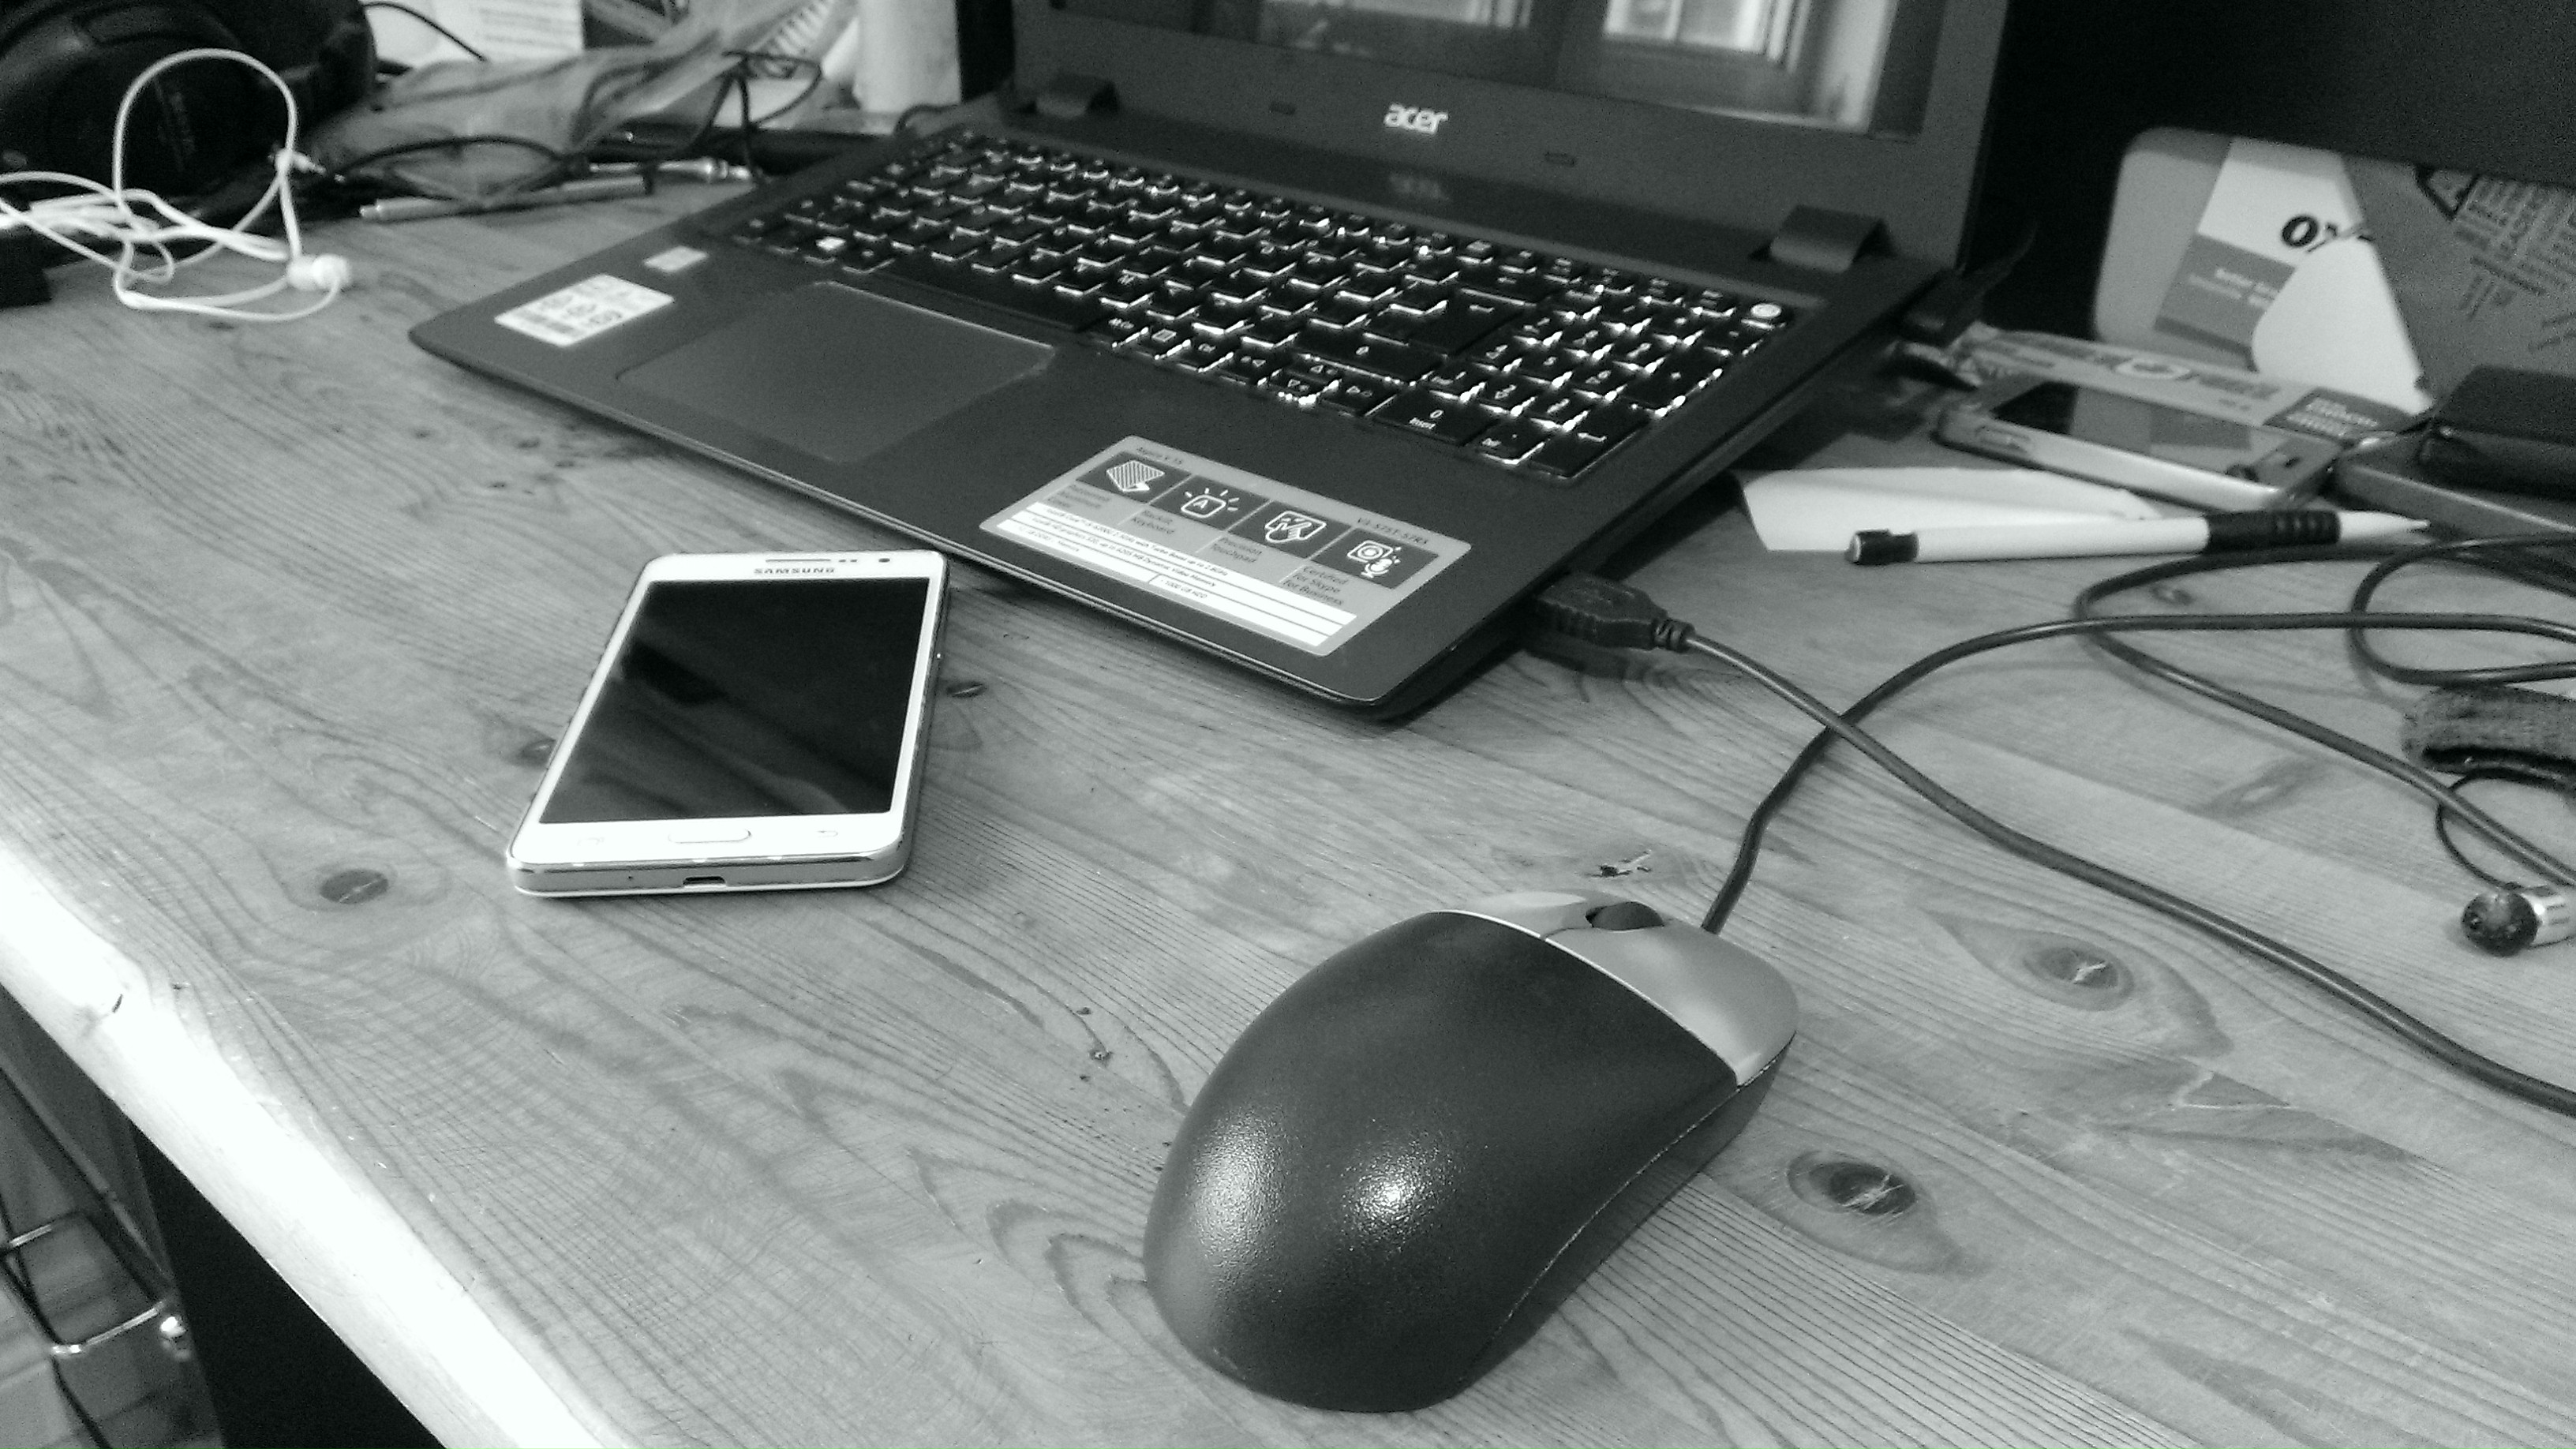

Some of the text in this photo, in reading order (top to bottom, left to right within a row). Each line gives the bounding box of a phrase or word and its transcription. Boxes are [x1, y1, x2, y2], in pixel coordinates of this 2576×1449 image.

[1383, 103, 1449, 134] acer
[1208, 543, 1258, 564] Touchpad
[1302, 566, 1348, 585] Certified
[1307, 578, 1342, 594] Skype
[1282, 579, 1346, 605] for Business
